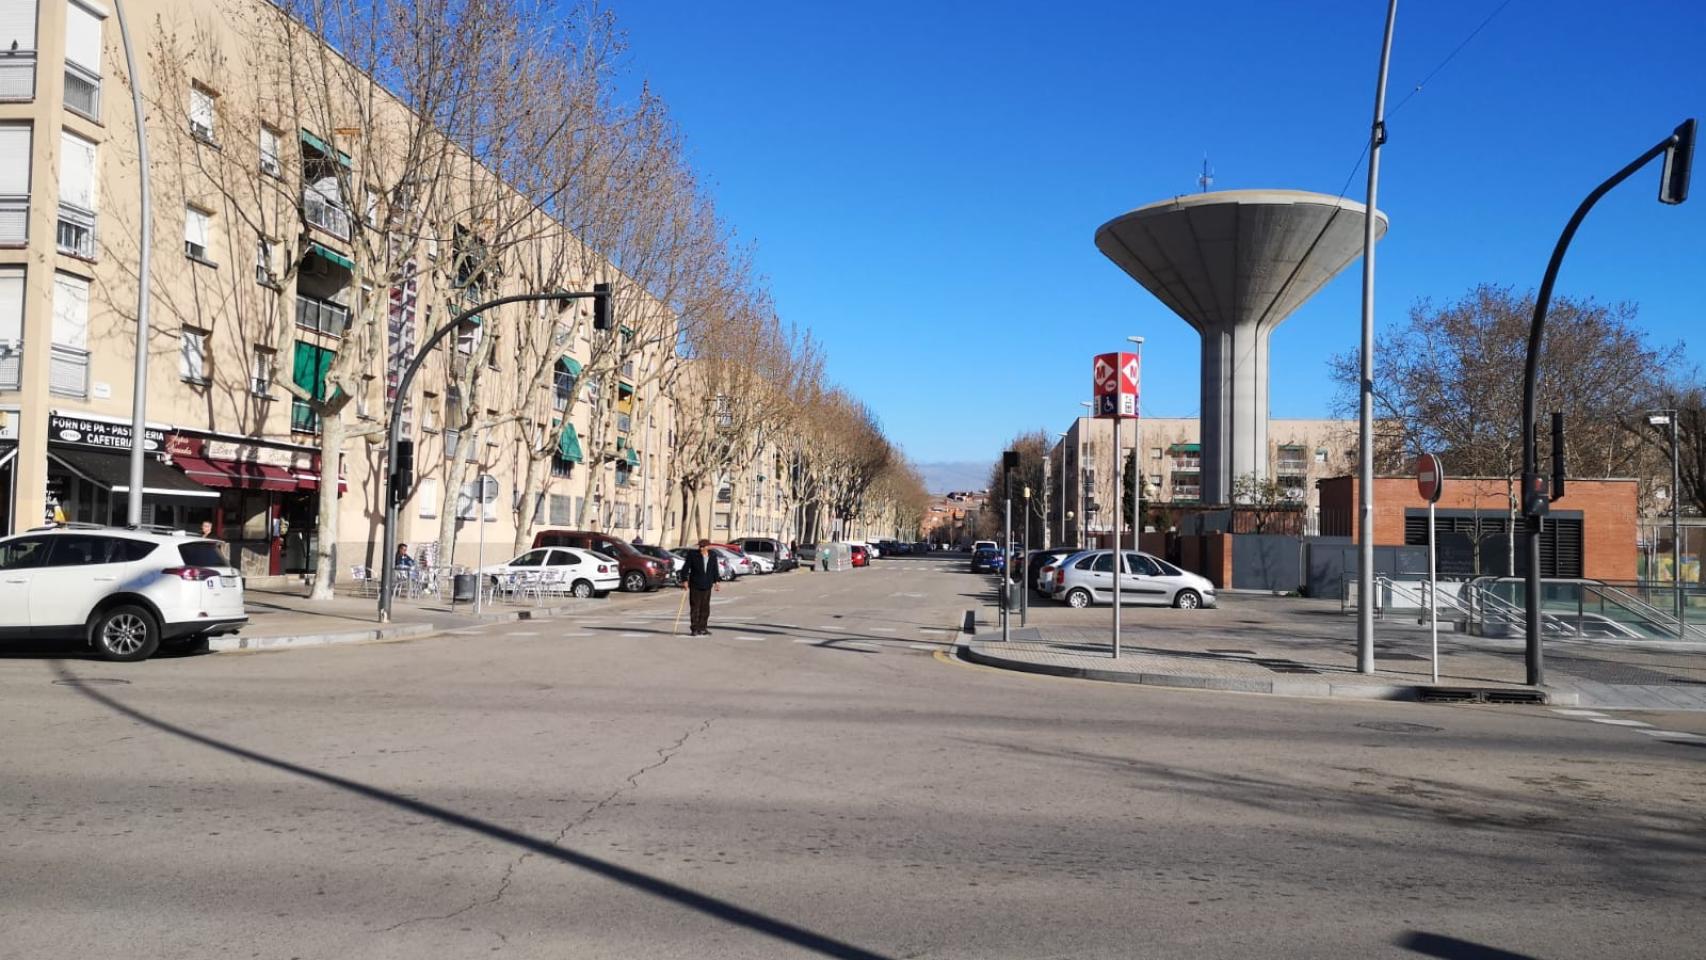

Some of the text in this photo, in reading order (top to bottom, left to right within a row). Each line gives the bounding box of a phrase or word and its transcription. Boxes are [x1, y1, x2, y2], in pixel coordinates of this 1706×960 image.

[1097, 365, 1106, 379] M
[52, 418, 78, 430] FORN
[80, 421, 92, 431] DE
[93, 424, 105, 433] PA
